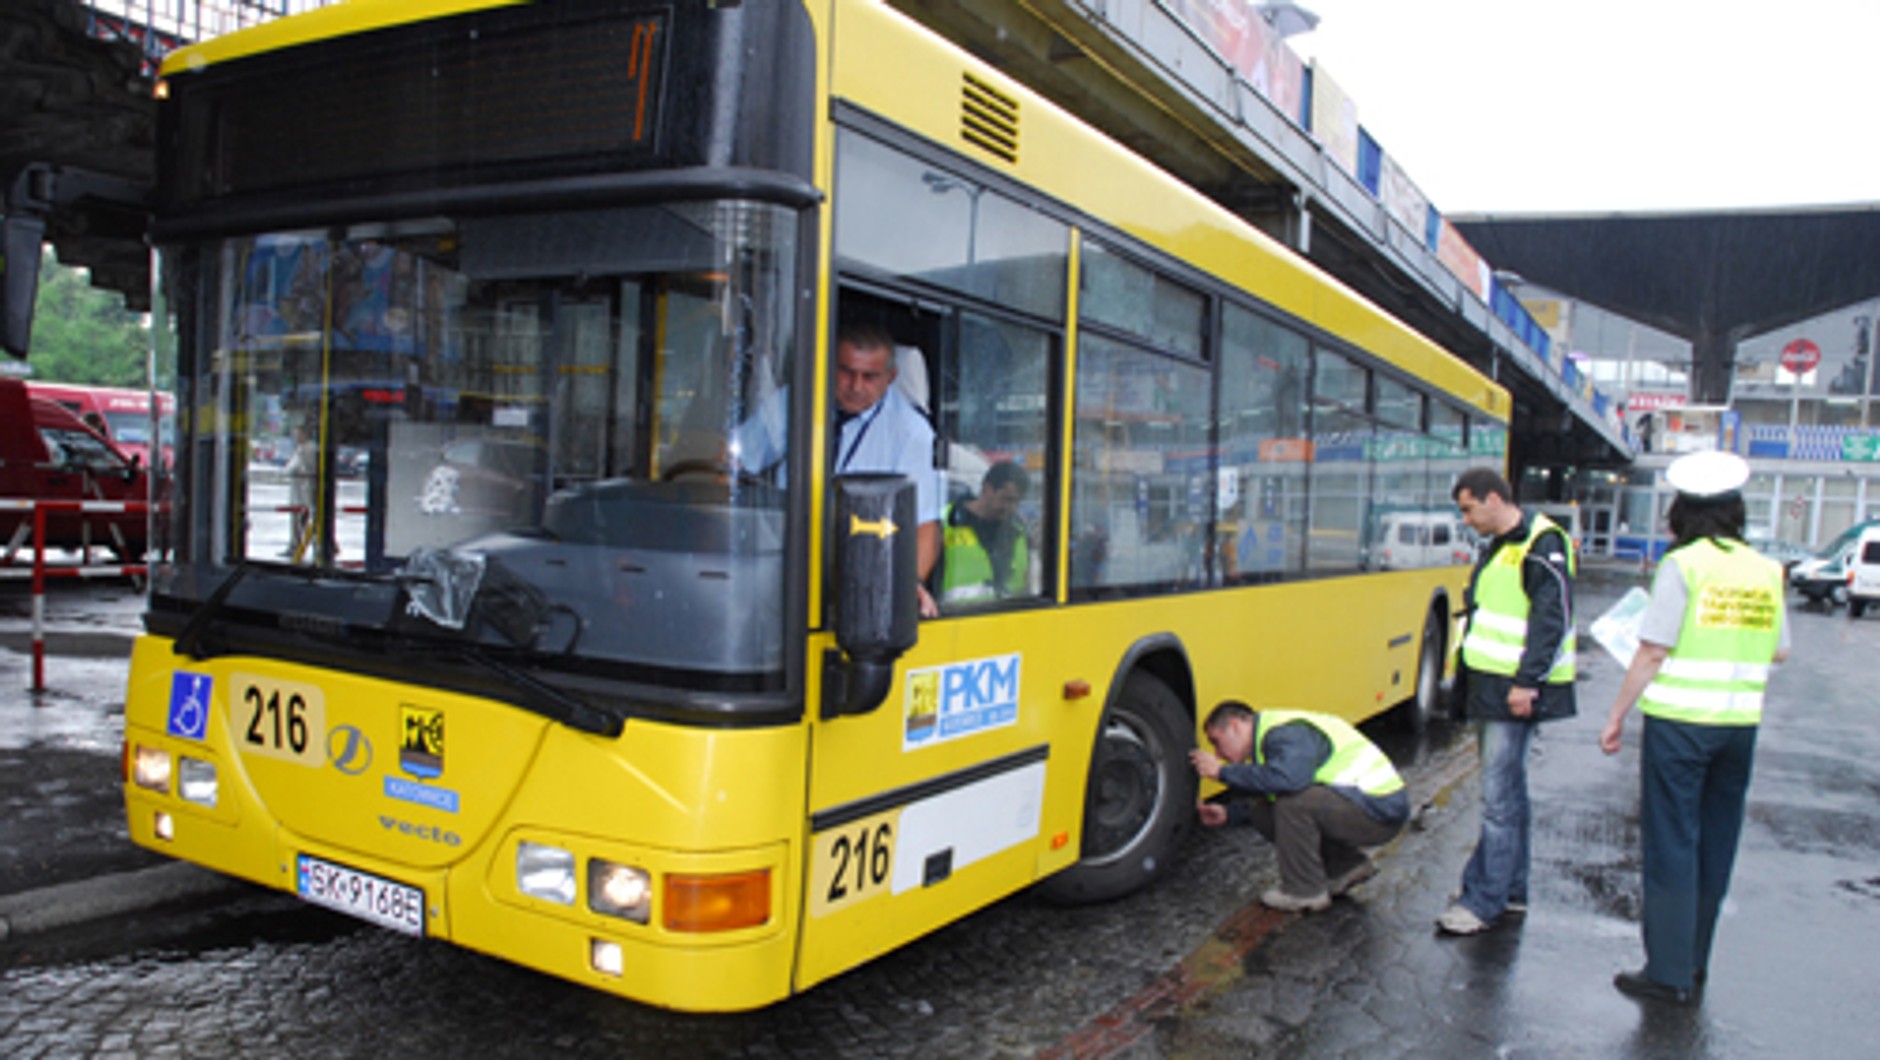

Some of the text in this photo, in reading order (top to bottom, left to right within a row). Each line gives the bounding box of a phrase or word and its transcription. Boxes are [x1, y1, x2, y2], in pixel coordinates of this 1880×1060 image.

[943, 656, 1019, 712] PKM
[245, 685, 307, 754] 216
[378, 815, 462, 847] vecto
[827, 822, 891, 902] 216
